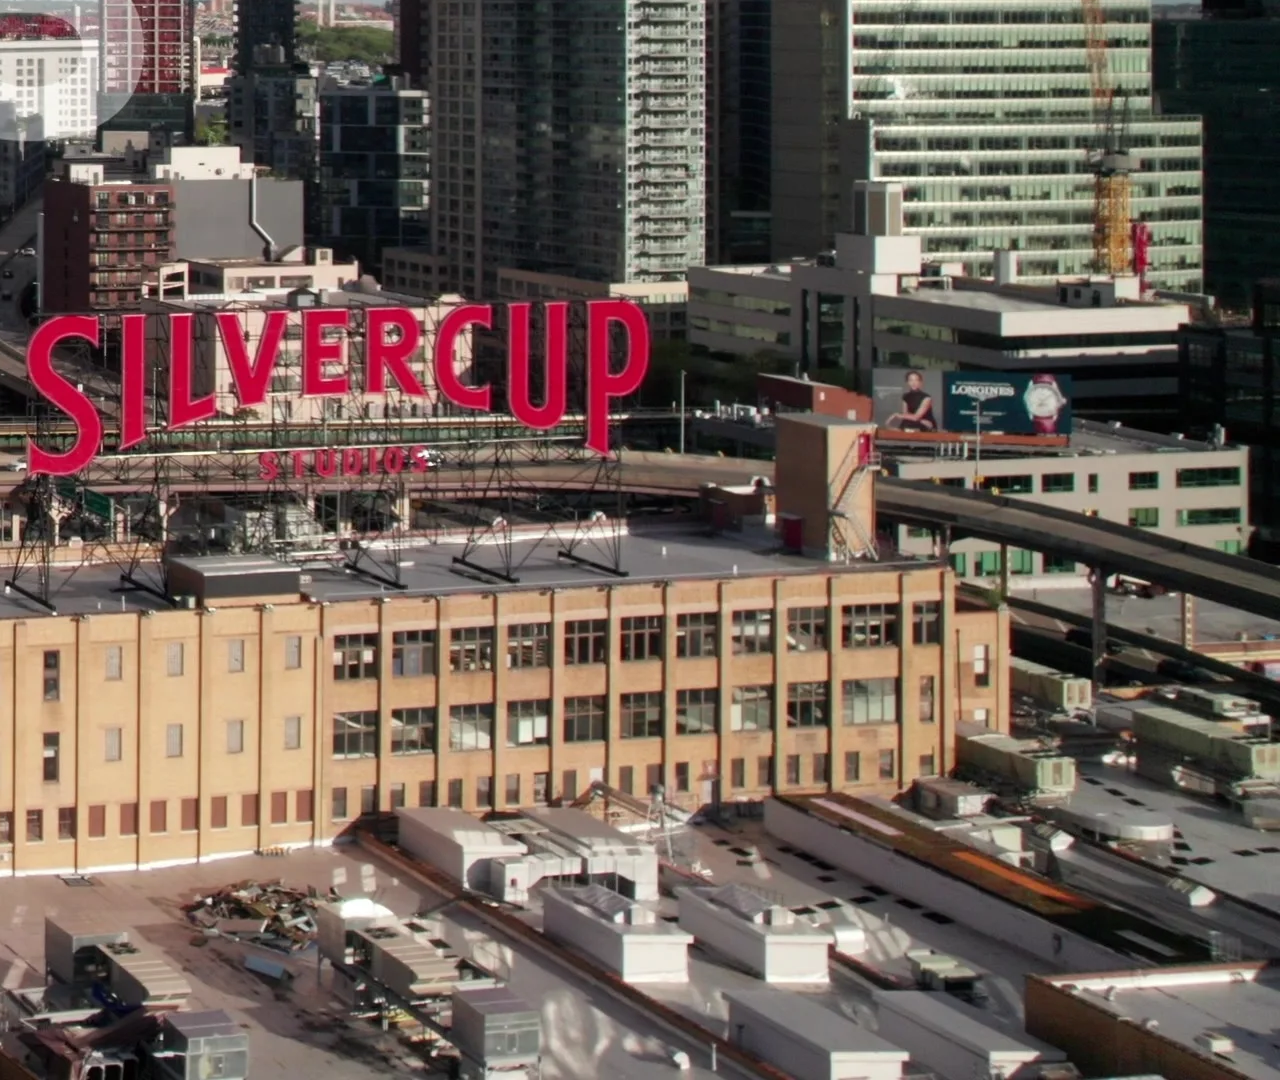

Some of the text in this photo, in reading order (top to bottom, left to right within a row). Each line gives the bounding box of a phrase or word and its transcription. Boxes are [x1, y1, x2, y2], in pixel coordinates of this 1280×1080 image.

[26, 298, 651, 476] SILVERCUP
[951, 385, 1015, 397] LONGINES
[258, 444, 428, 481] STUDIOS
